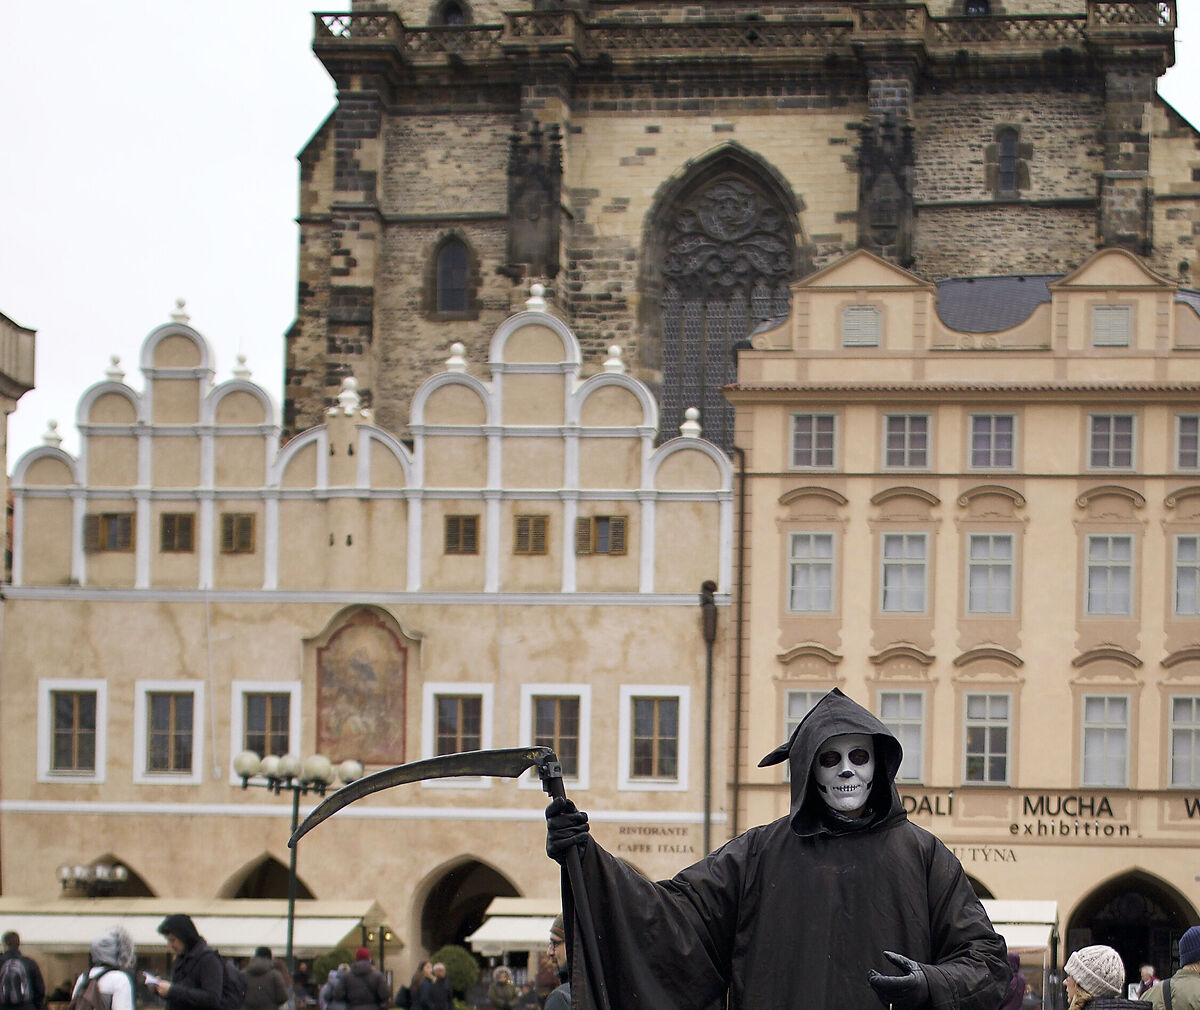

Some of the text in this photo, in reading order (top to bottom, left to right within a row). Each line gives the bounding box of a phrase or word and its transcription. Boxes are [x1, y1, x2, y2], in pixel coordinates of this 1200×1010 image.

[1023, 796, 1113, 817] MUCHA
[619, 826, 688, 836] RISTORANTE
[1009, 820, 1129, 837] exhibition
[658, 844, 694, 854] ITALIA
[968, 845, 1017, 862] TÝNA
